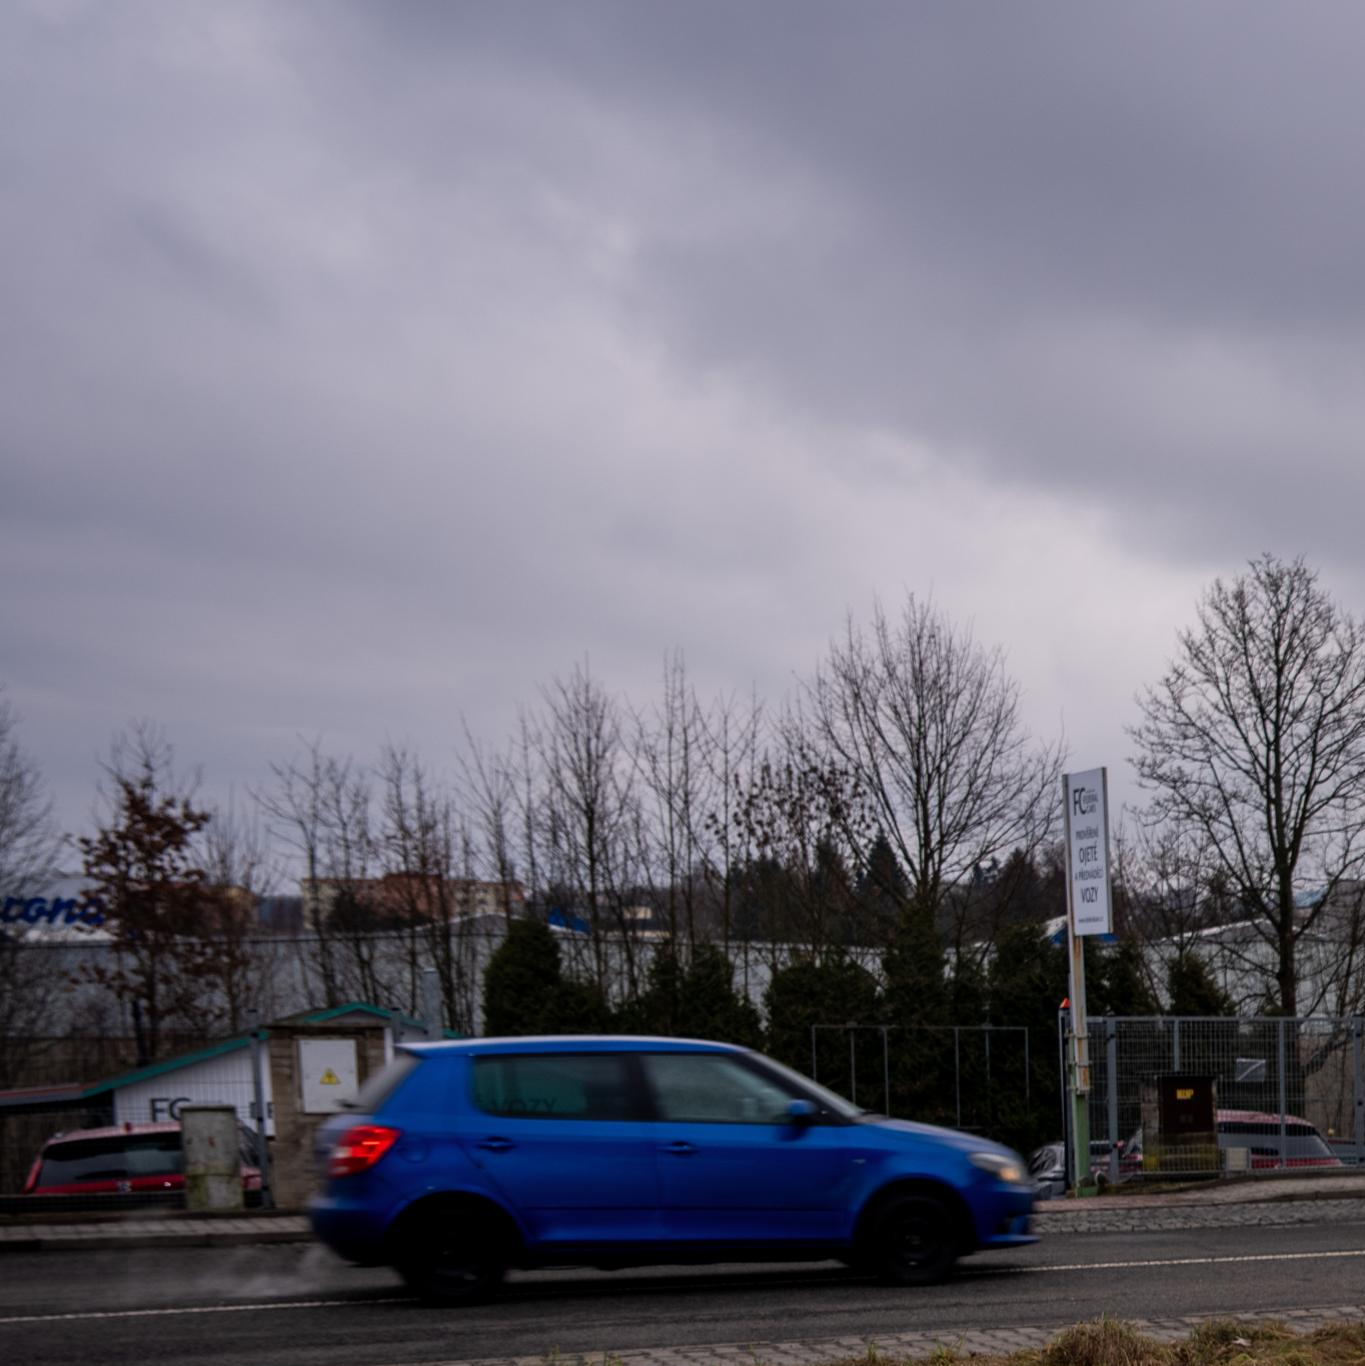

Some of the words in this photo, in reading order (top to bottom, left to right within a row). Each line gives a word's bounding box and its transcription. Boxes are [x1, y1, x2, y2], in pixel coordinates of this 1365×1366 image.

[1073, 787, 1087, 817] FC
[1079, 841, 1098, 866] OJETÉ
[1081, 886, 1099, 904] VOZY
